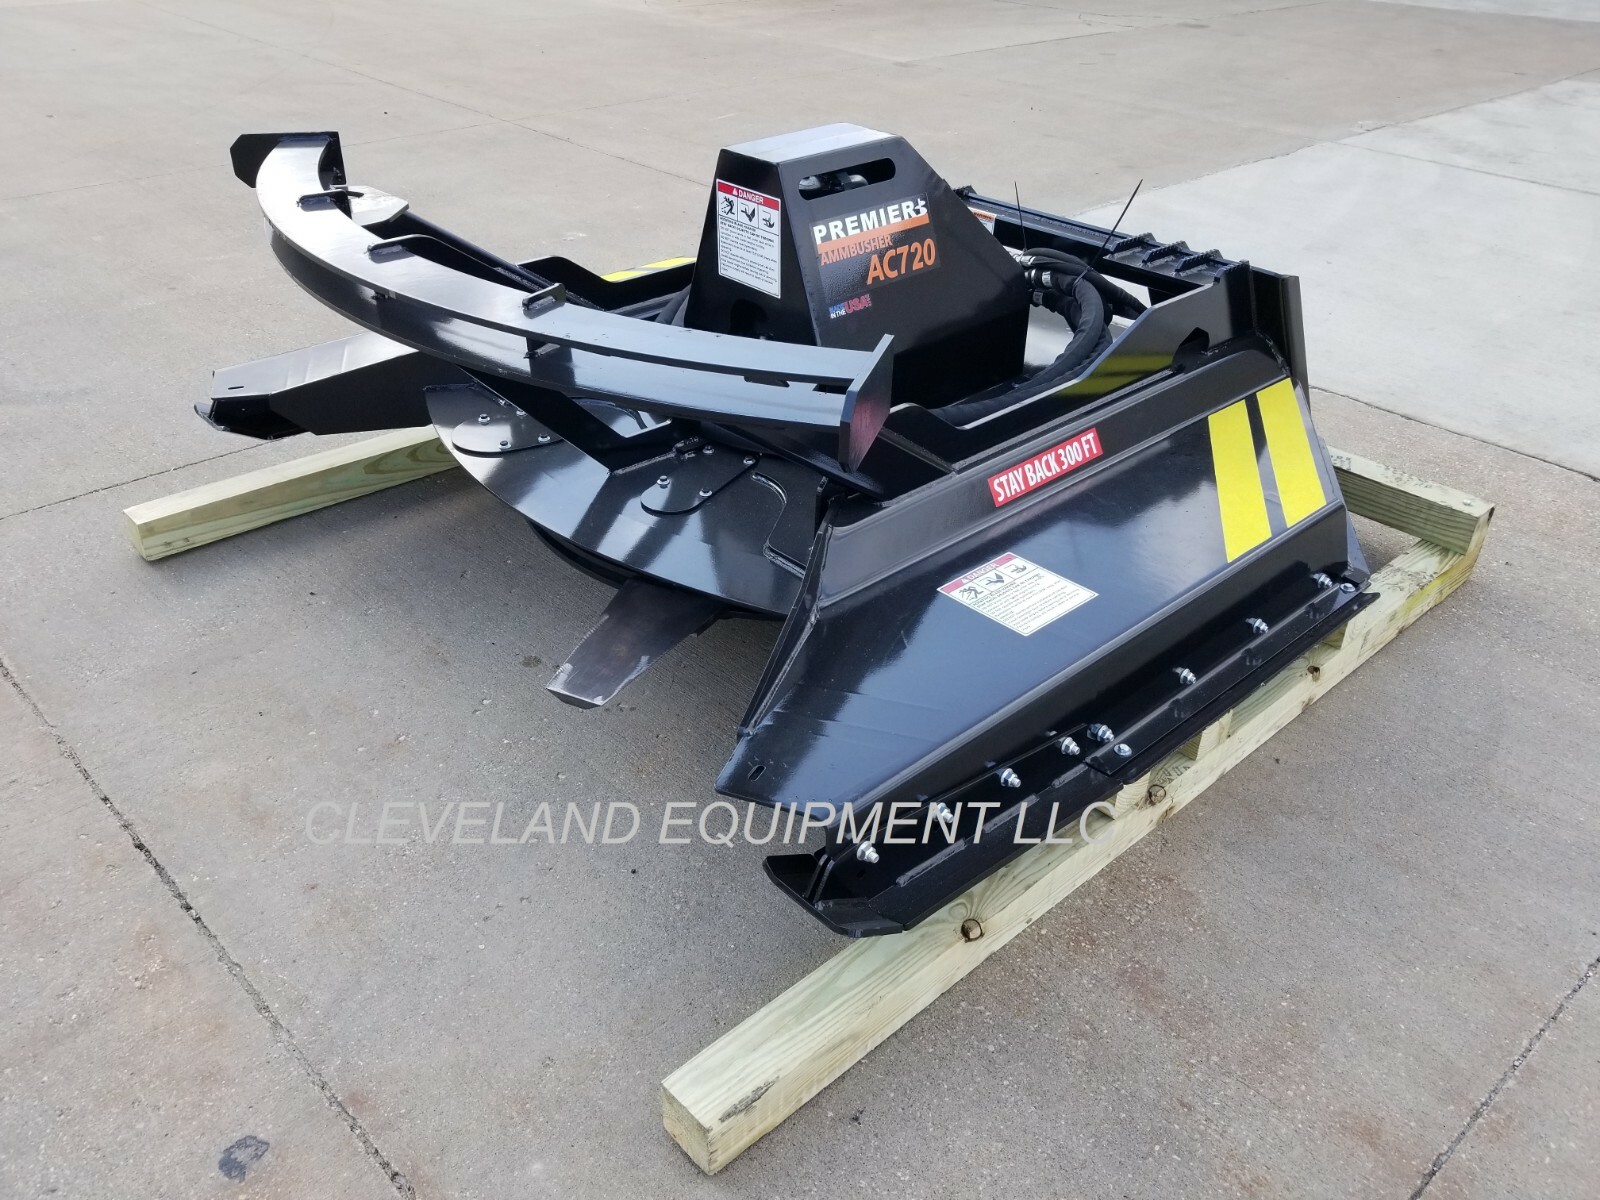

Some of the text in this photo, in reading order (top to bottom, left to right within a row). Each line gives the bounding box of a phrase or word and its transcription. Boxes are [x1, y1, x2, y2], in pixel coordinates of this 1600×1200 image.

[738, 189, 764, 204] DANGER
[812, 200, 915, 245] PREMIER
[820, 234, 893, 266] AMMBUSHER
[866, 238, 936, 285] AC720
[844, 295, 868, 314] USA
[993, 432, 1098, 502] STAY BACK 300 FT
